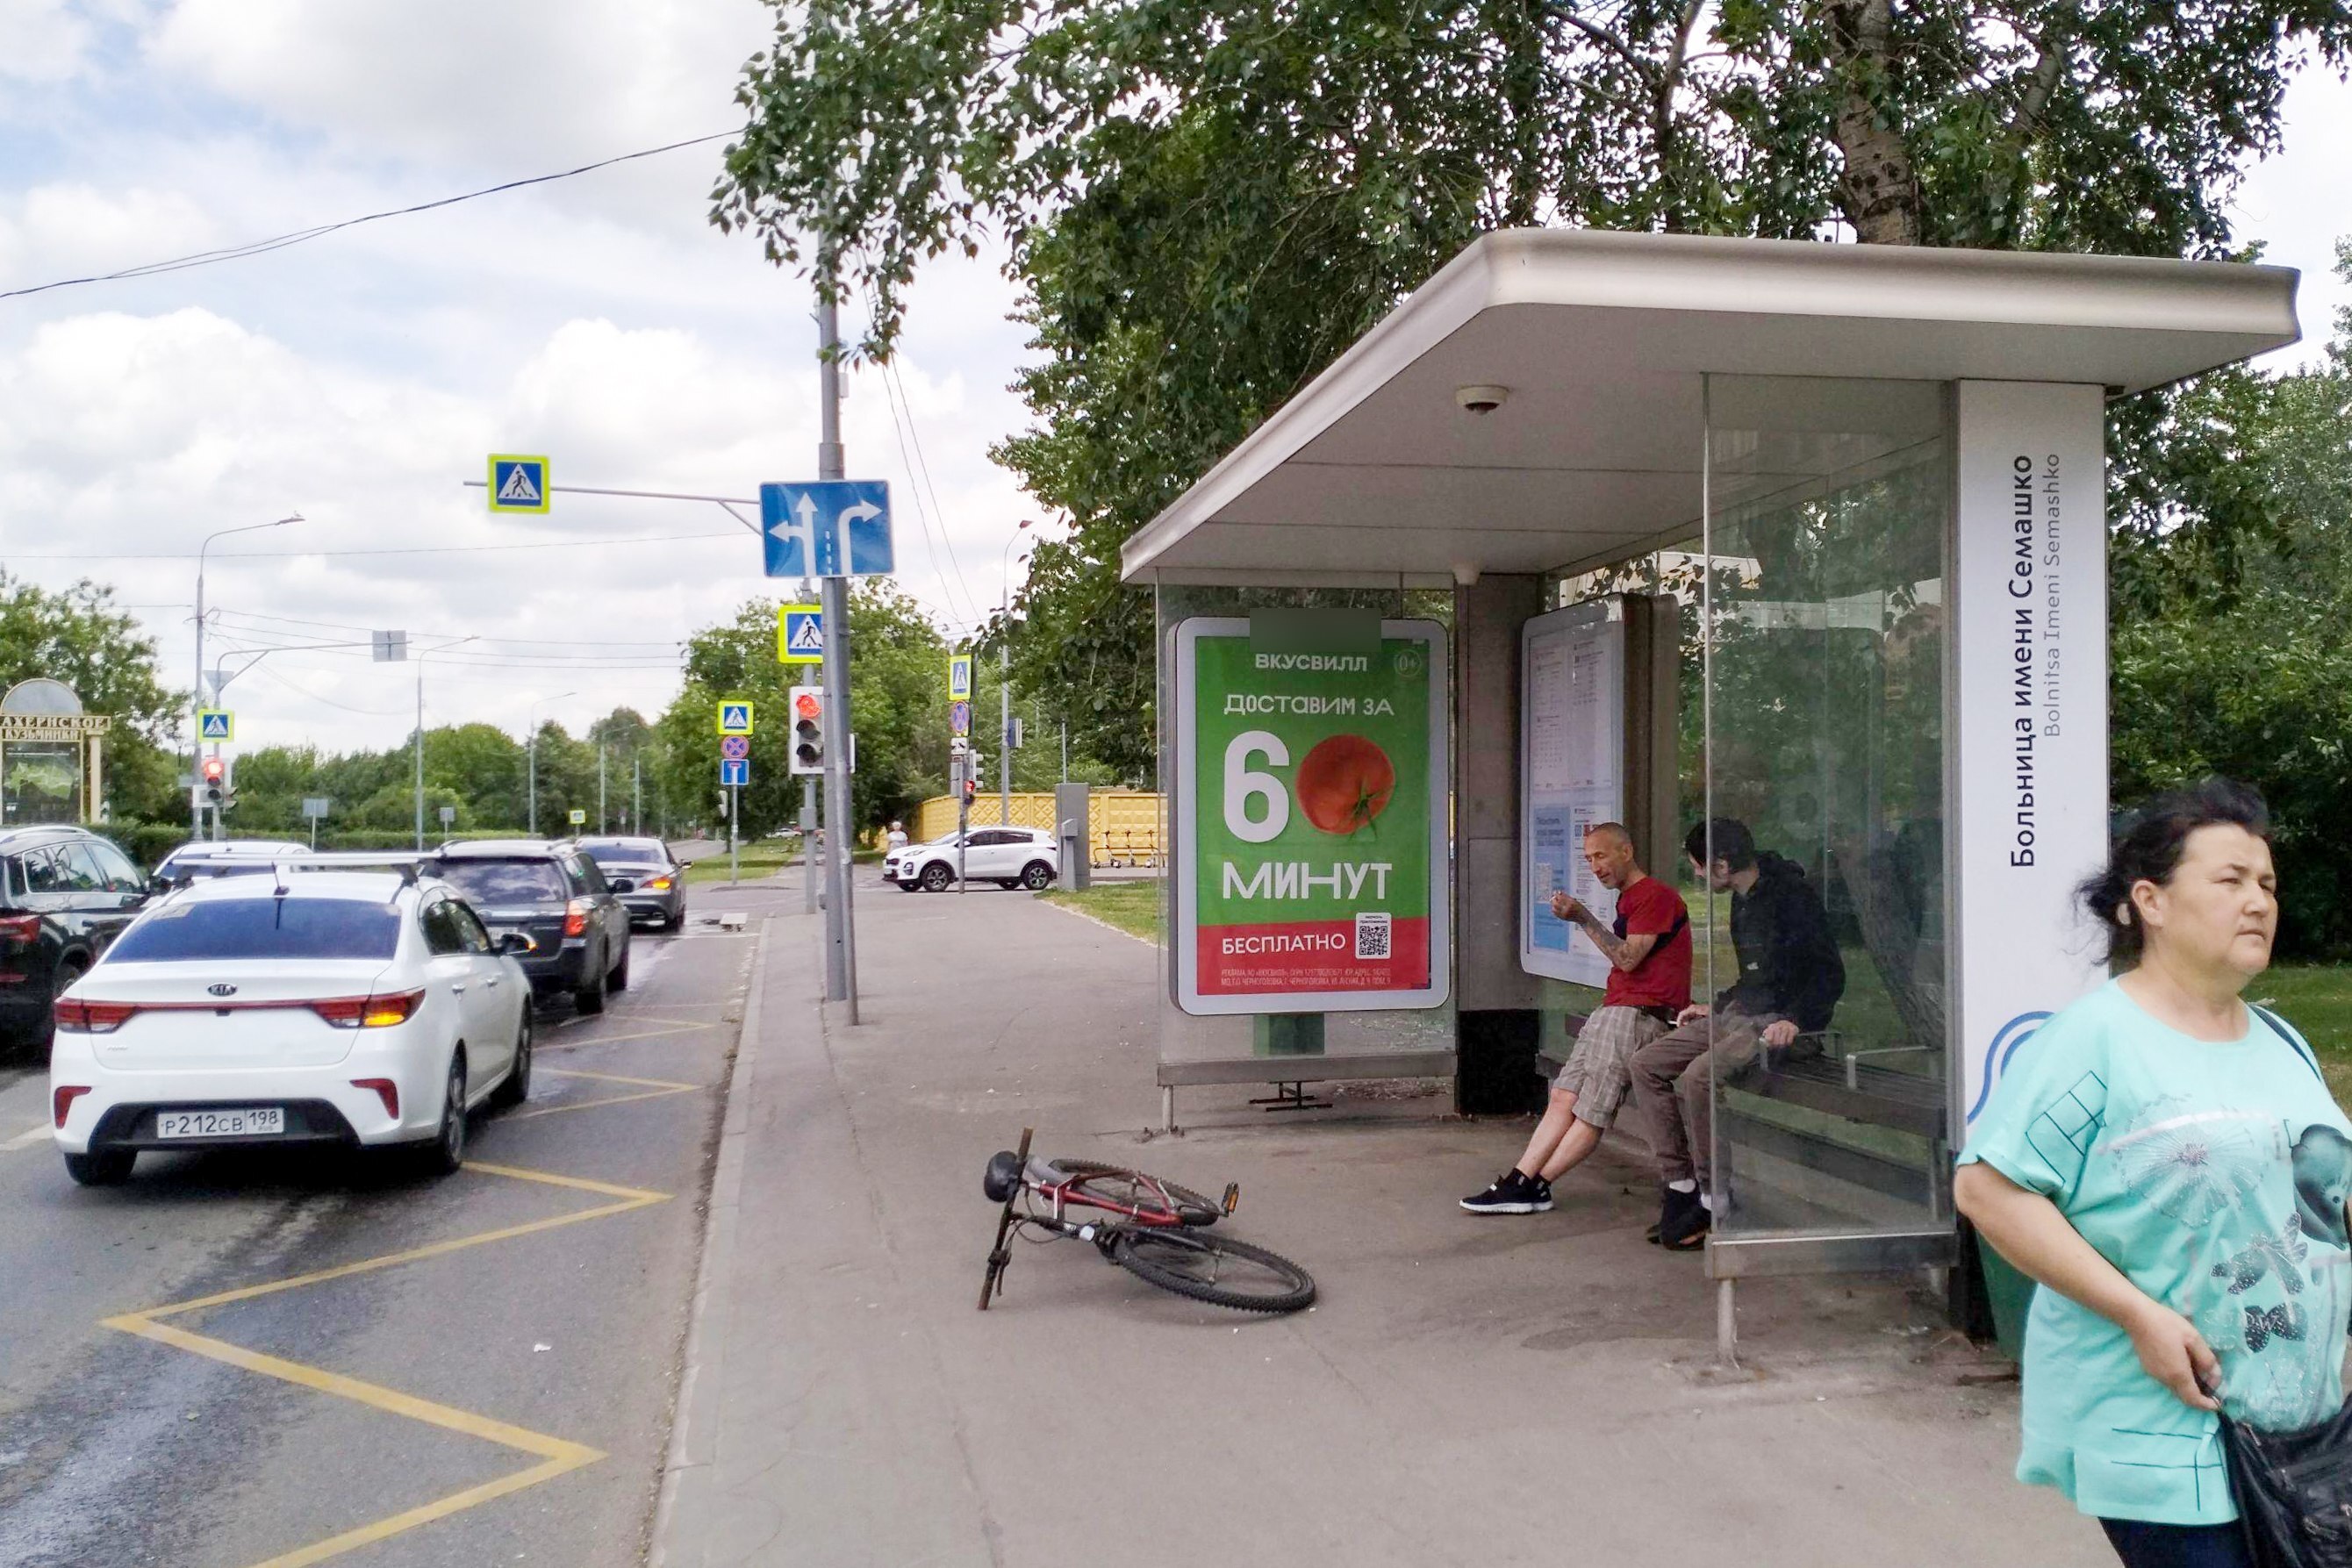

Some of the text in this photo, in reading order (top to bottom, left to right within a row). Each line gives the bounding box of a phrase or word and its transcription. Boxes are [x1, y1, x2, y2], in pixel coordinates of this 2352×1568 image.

[2041, 453, 2061, 737] Bolnitsa Imeni Semashko
[1255, 653, 1367, 672] ВКУСВИЛЛ
[2008, 455, 2036, 867] Больница имени Семашко
[1362, 698, 1395, 716] ЗА
[1223, 862, 1393, 900] МИНУТ
[1223, 933, 1346, 955] БЕСПЛАТНО
[209, 984, 237, 996] KIA
[249, 1110, 278, 1126] 198
